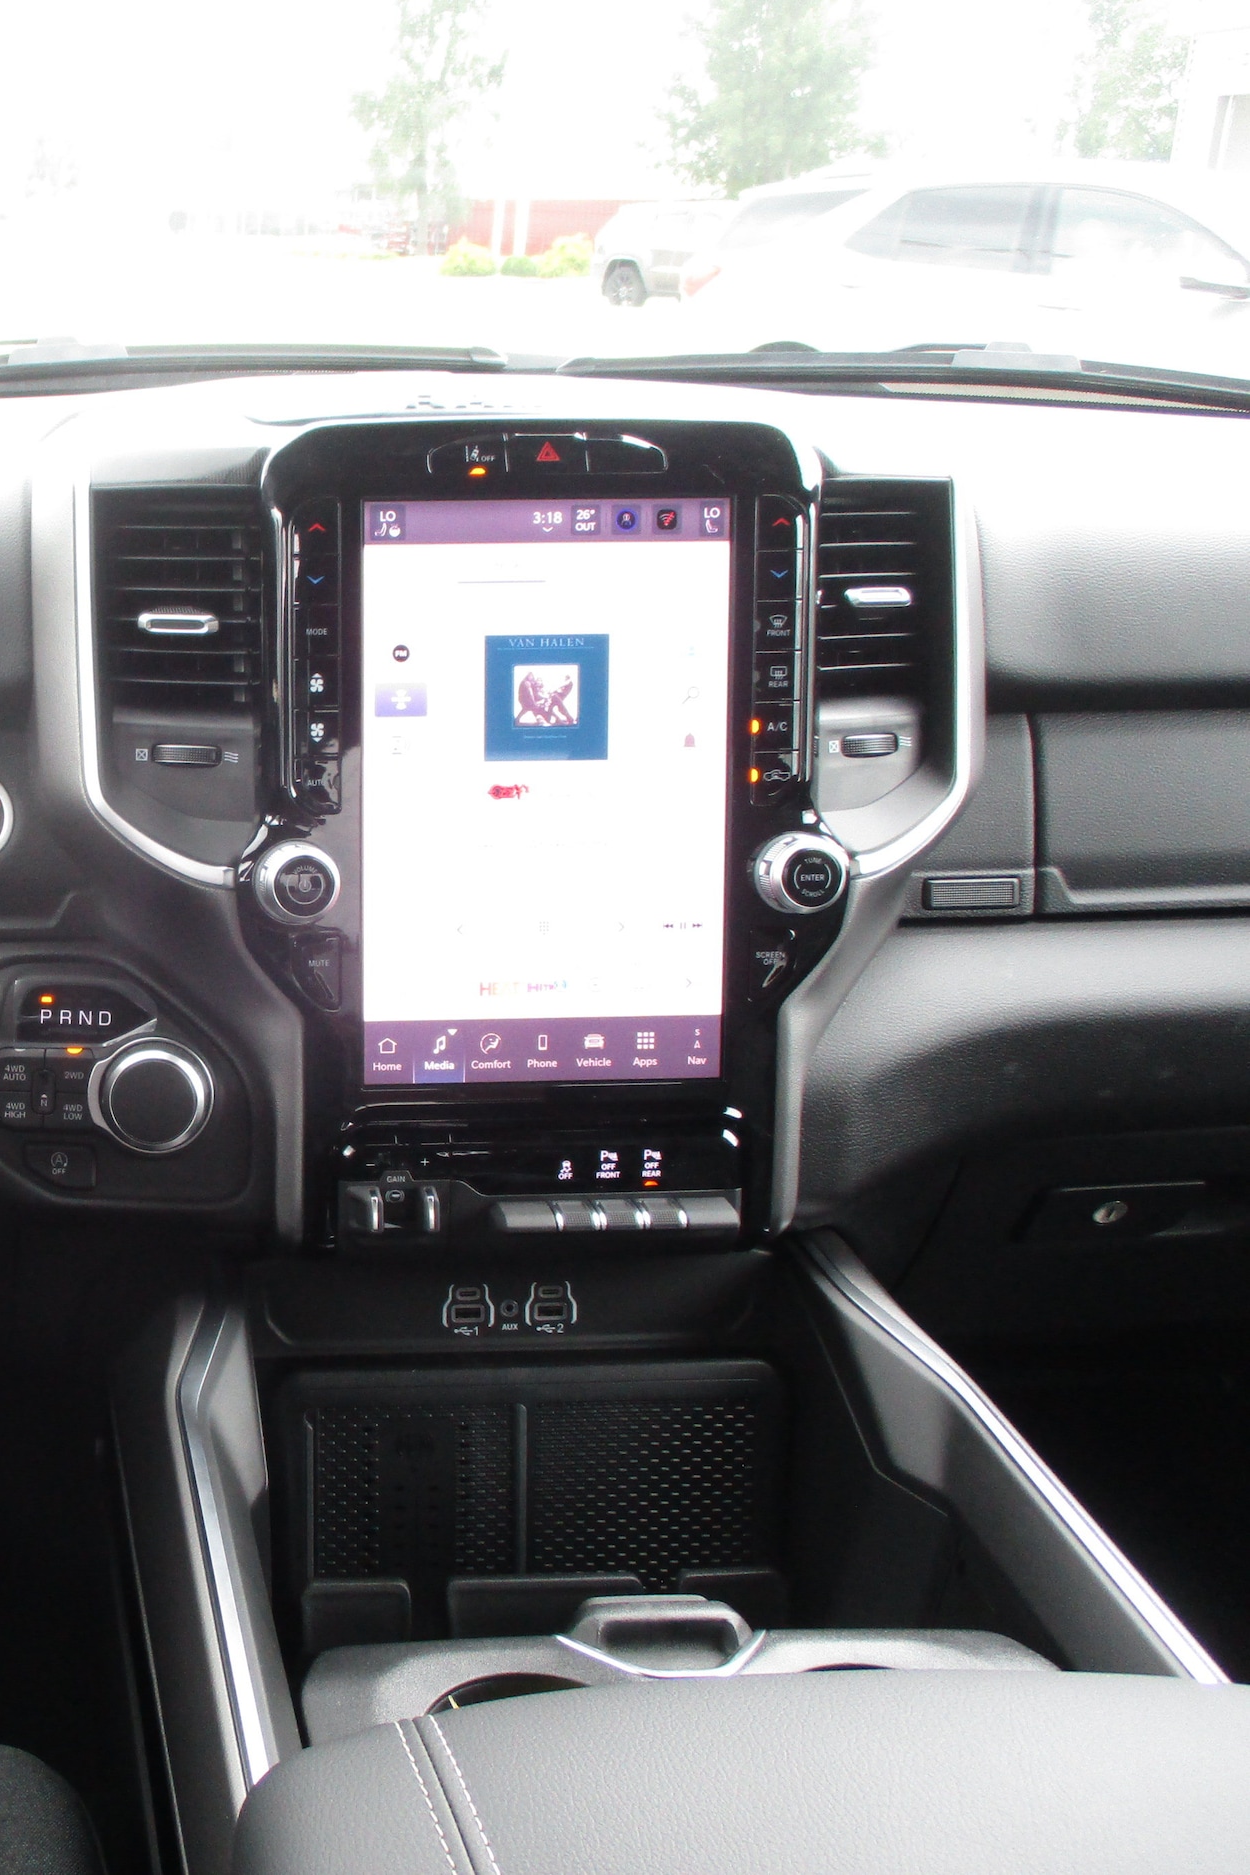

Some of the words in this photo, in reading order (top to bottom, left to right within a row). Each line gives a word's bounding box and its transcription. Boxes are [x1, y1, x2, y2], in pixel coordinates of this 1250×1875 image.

[481, 455, 495, 463] OFF
[380, 511, 396, 522] LO
[704, 507, 720, 519] LO
[533, 511, 562, 525] 3:18
[575, 522, 596, 532] OUT
[509, 638, 534, 647] VAN
[540, 637, 584, 647] HALEN
[767, 722, 788, 731] A/C
[292, 865, 318, 875] VOLUME
[801, 888, 825, 898] SCROLL
[756, 951, 785, 959] SCREEN
[308, 959, 329, 967] MUTE
[40, 1009, 52, 1024] P
[59, 1010, 72, 1025] R
[79, 1011, 92, 1026] N
[99, 1011, 112, 1026] D
[471, 1059, 511, 1070] Comfort
[527, 1058, 558, 1070] Phone
[576, 1057, 612, 1068] Vehicle
[633, 1057, 658, 1069] Apps
[687, 1055, 707, 1066] Nav
[4, 1065, 25, 1073] 4WD
[373, 1061, 402, 1072] Home
[424, 1060, 455, 1071] Media
[3, 1073, 26, 1081] AUTO
[64, 1071, 85, 1080] 2WD
[6, 1102, 26, 1110] 4WD
[63, 1104, 83, 1112] 4WD
[4, 1111, 26, 1119] HIGH
[63, 1112, 83, 1121] LOW
[52, 1167, 67, 1175] OFF
[596, 1171, 620, 1179] FRONT
[641, 1170, 661, 1178] REAR
[386, 1175, 406, 1183] GAIN
[502, 1323, 518, 1331] AUX
